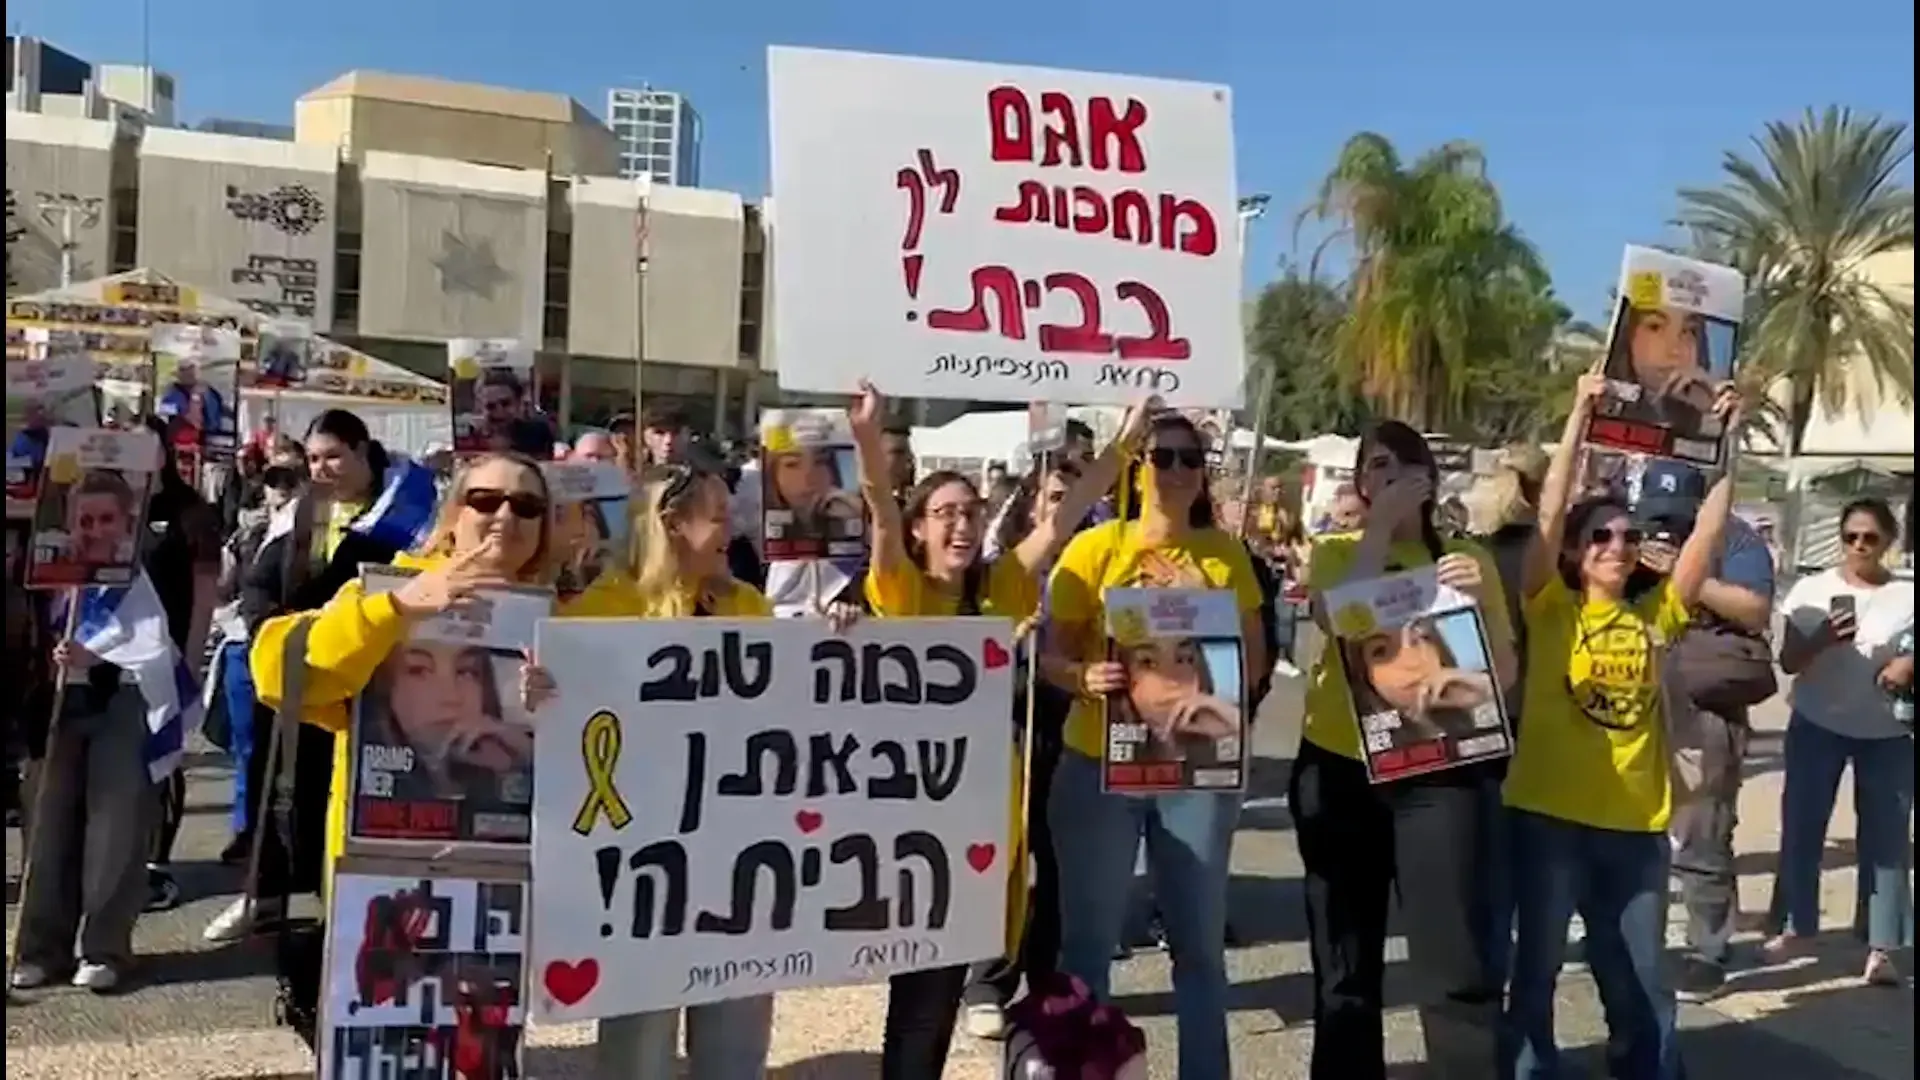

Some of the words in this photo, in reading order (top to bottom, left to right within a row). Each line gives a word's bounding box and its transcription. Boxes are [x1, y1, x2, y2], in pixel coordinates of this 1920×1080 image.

[987, 85, 1148, 173] אגם
[897, 148, 960, 250] לך
[994, 179, 1218, 256] מחכות
[902, 254, 1191, 360] בבית!
[640, 631, 772, 702] טוב
[811, 640, 977, 704] כמה
[679, 729, 968, 834] שבאתן
[596, 830, 951, 939] הביתה!
